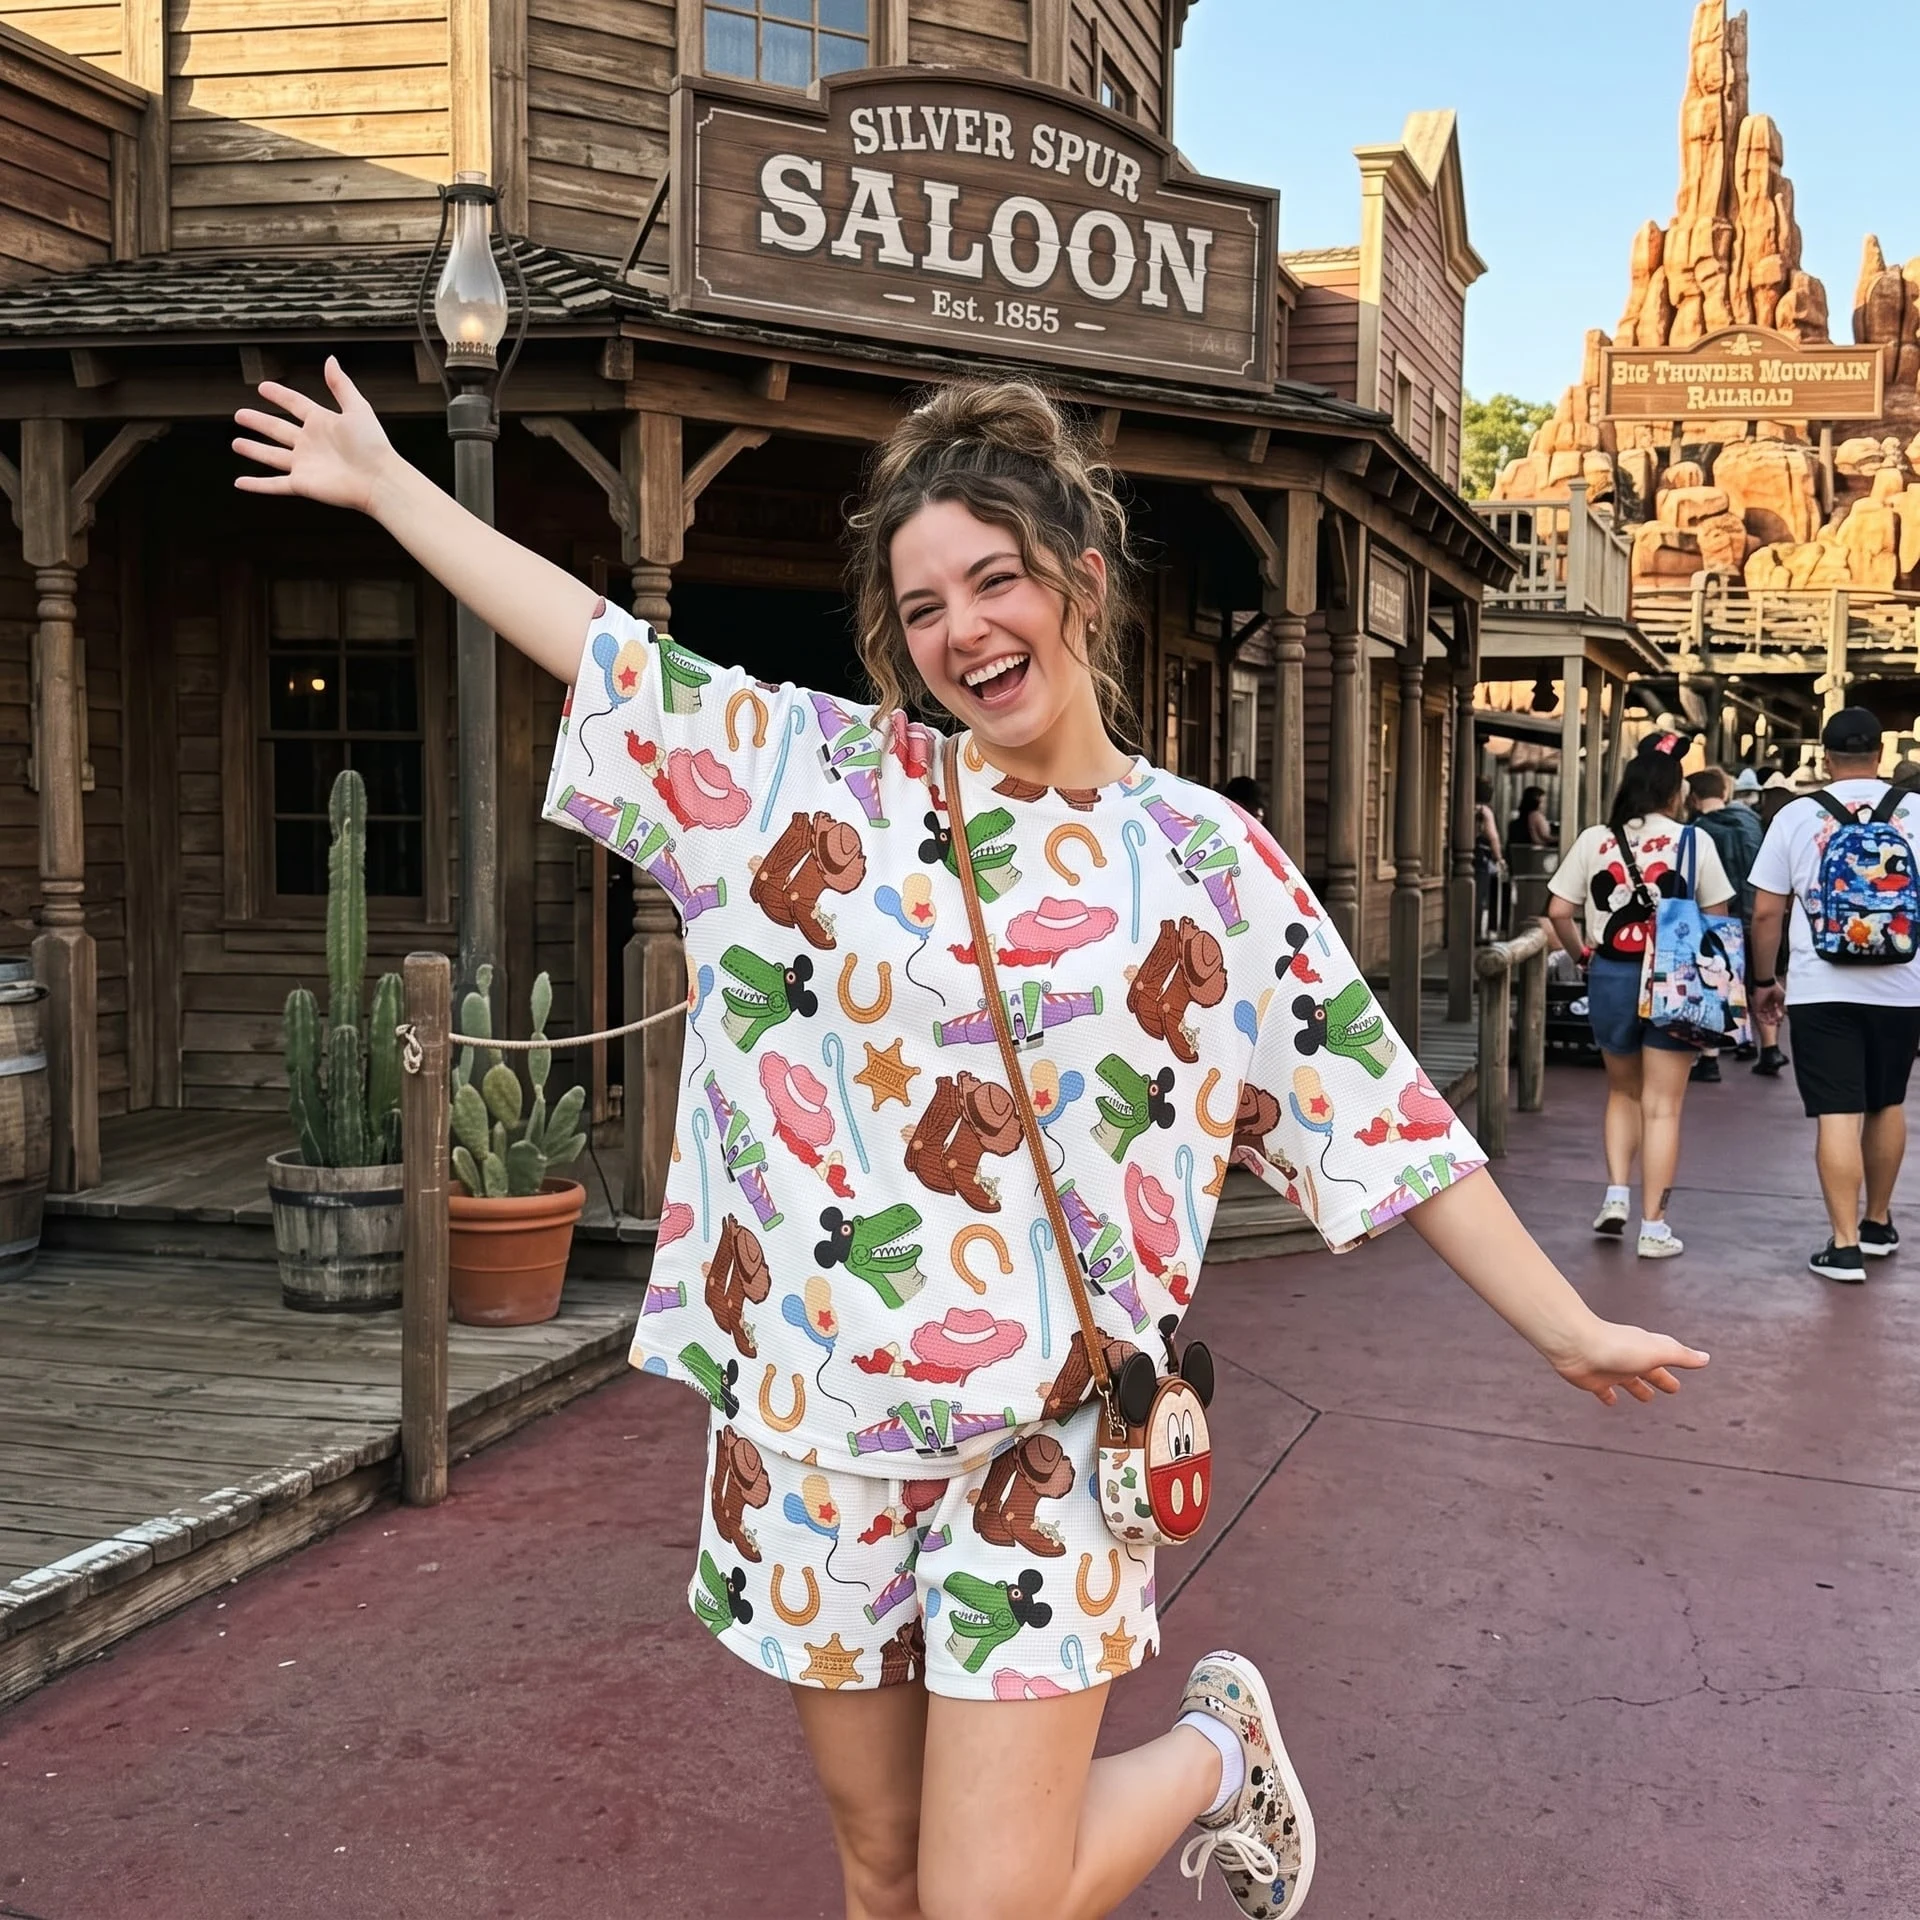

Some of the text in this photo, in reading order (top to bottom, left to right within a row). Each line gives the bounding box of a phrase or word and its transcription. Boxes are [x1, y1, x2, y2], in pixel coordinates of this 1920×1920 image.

[850, 105, 1142, 204] SILVER SPUR
[759, 154, 1214, 314] SALOON
[931, 290, 1060, 334] Est. 1855
